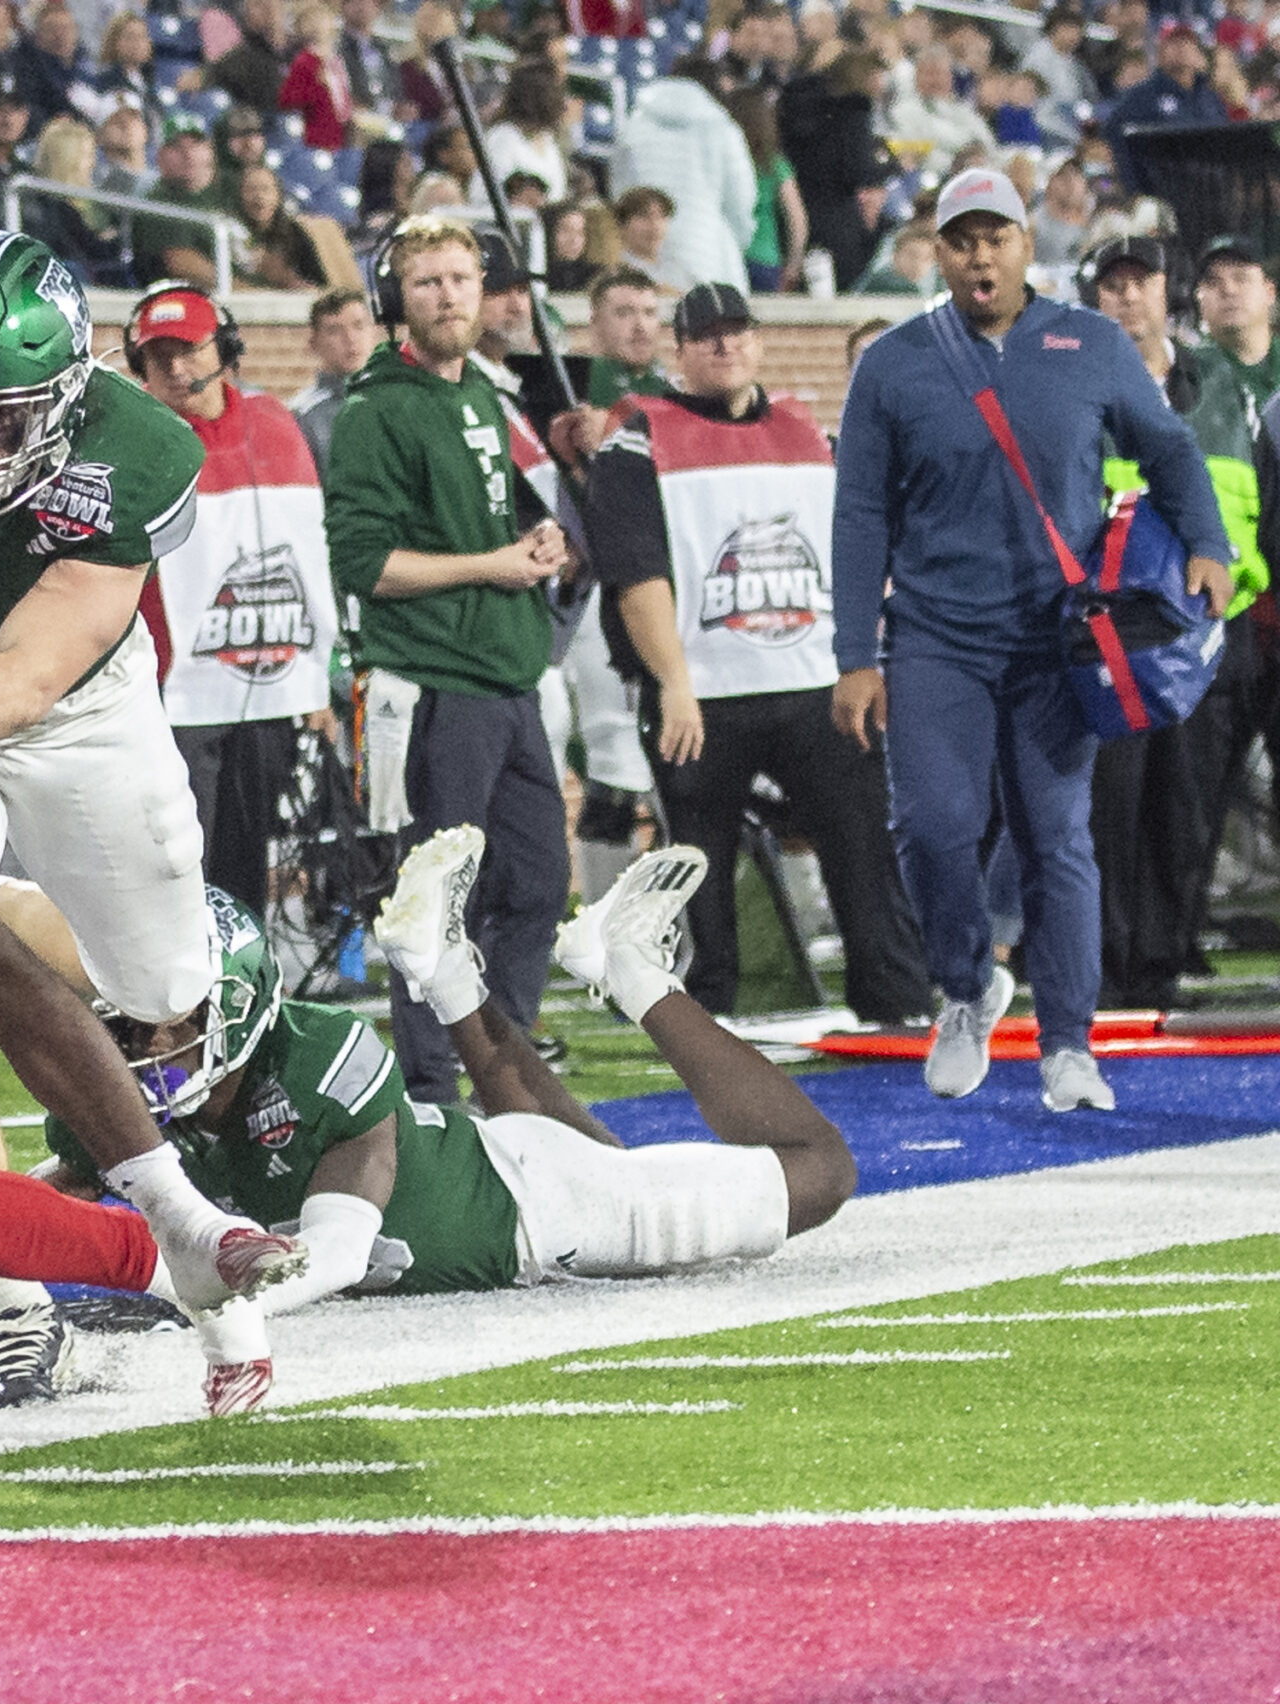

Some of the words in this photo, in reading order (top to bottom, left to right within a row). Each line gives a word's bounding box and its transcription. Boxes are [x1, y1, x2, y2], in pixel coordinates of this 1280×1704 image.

[28, 484, 114, 534] BOWL
[703, 569, 832, 620] BOWL
[193, 603, 314, 652] BOWL
[246, 1100, 300, 1140] BOWL
